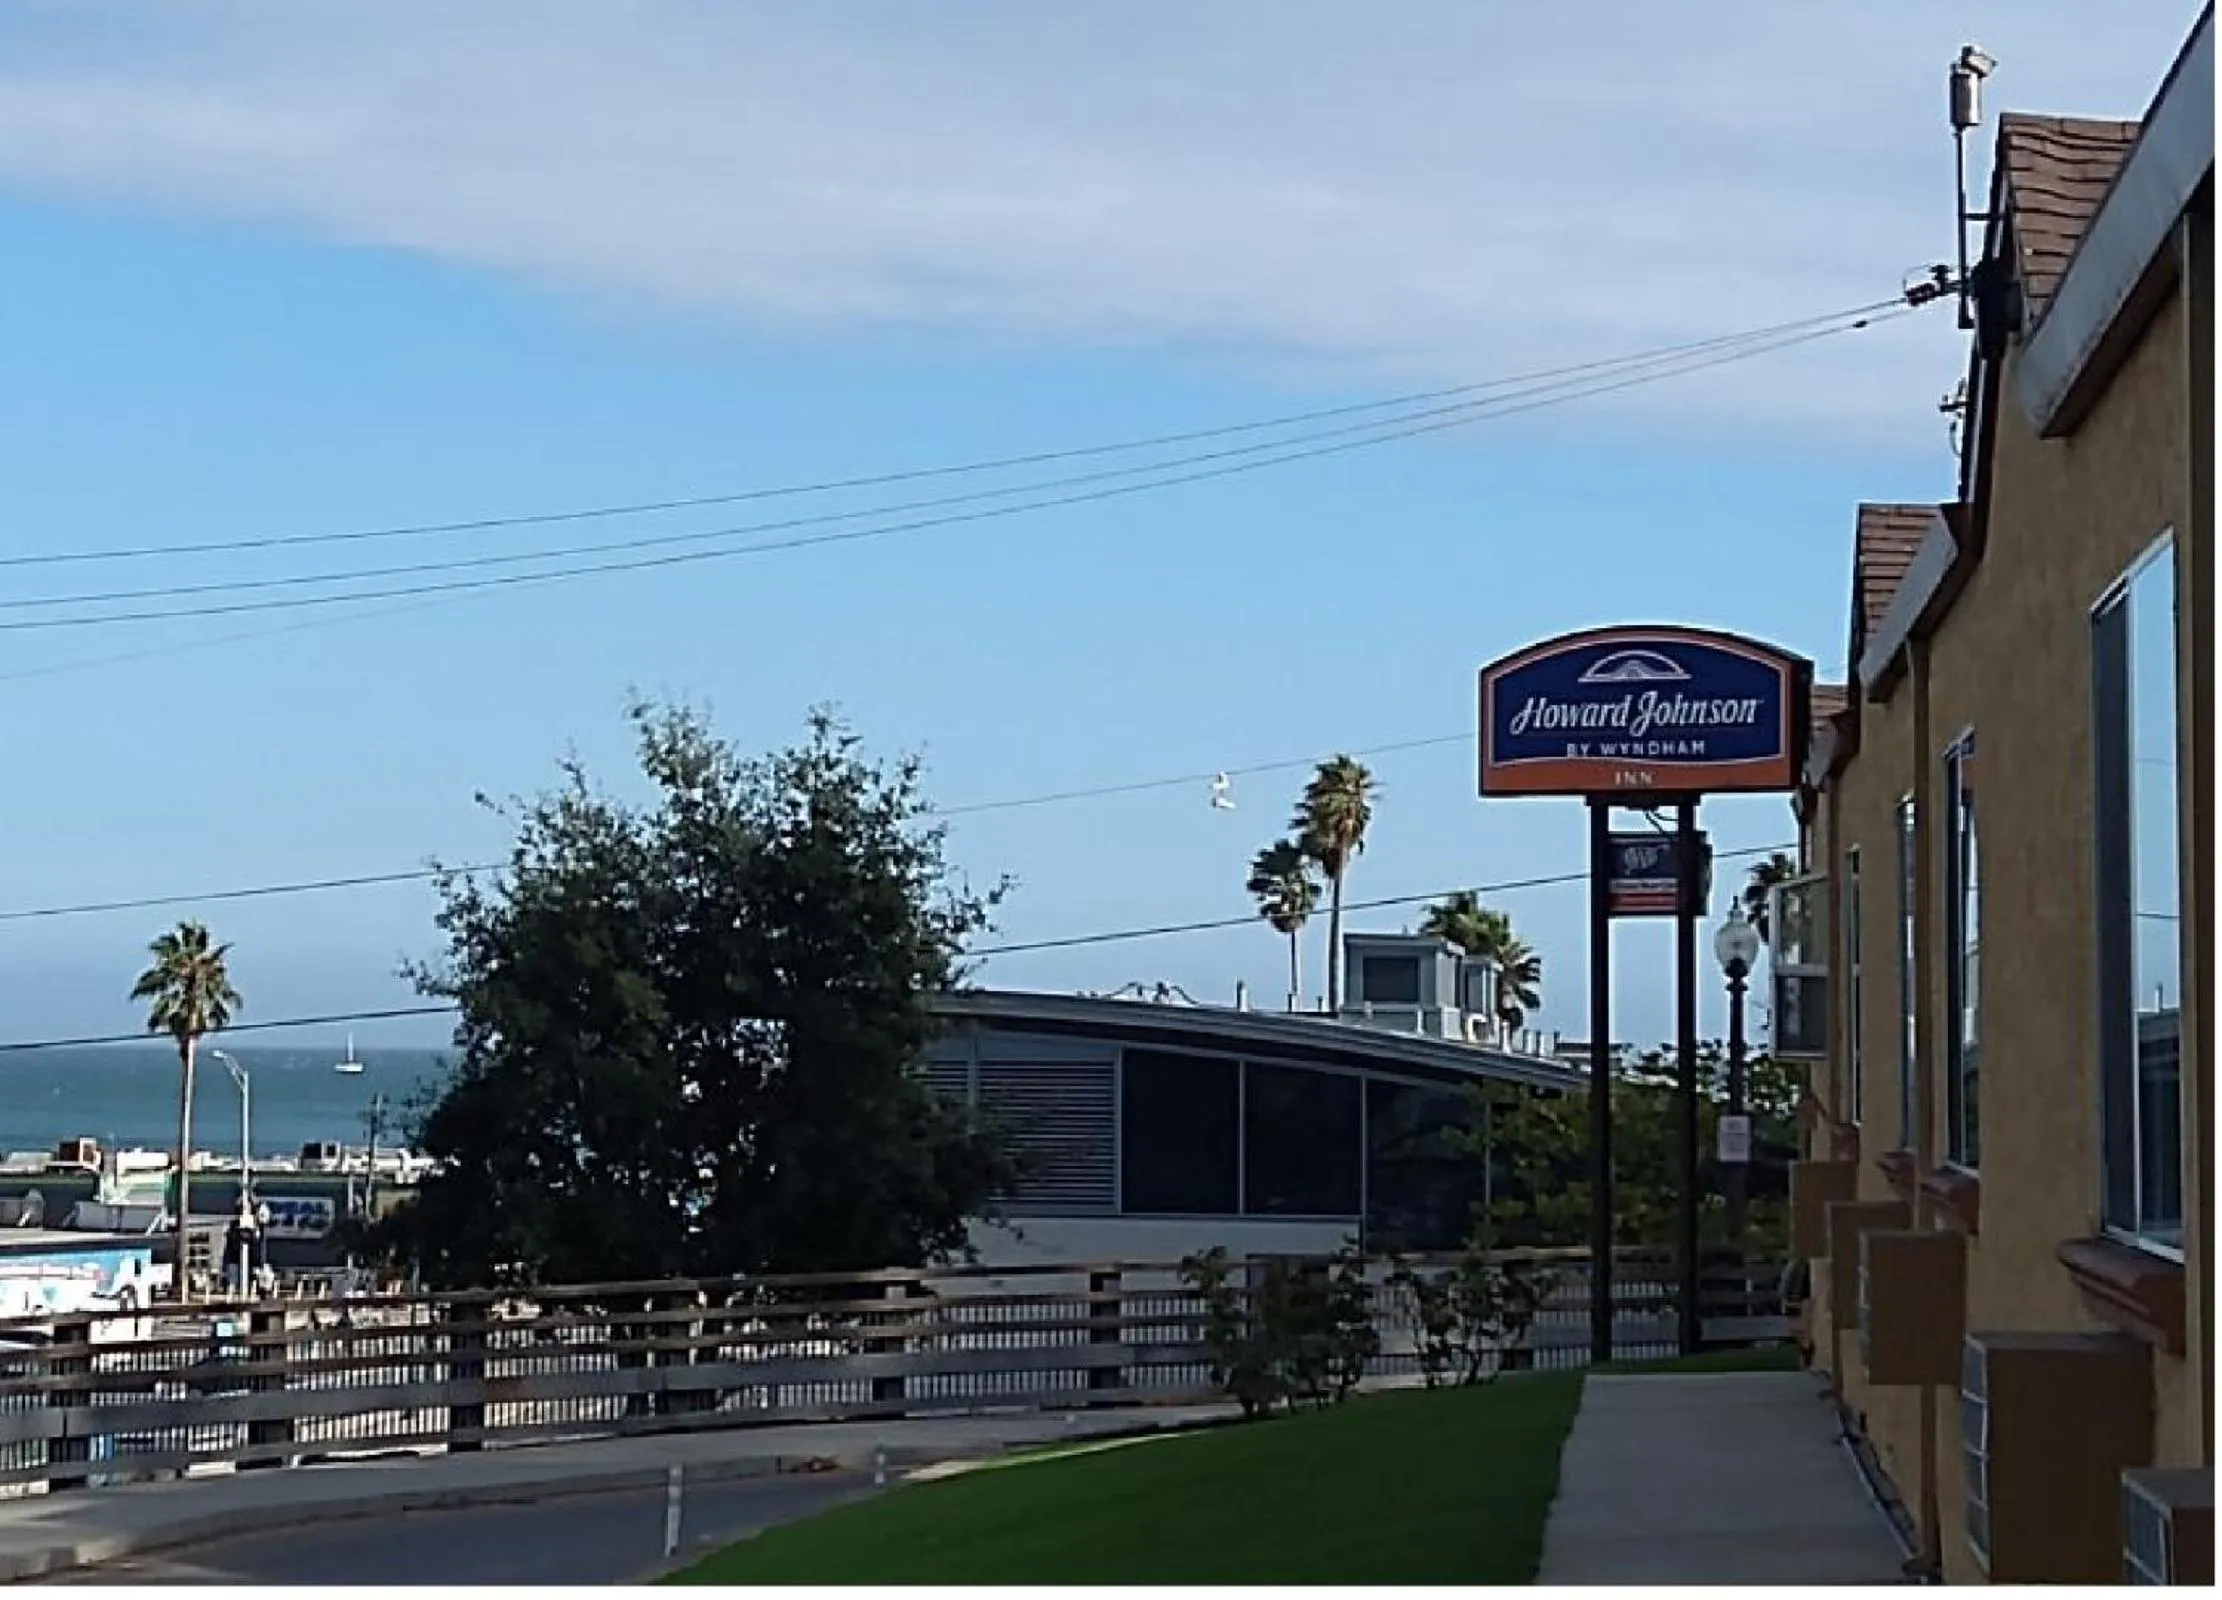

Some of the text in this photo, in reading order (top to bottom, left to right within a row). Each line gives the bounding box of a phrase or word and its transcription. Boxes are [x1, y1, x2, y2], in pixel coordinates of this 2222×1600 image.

[1510, 691, 1758, 736] Howard Johnson
[1567, 740, 1705, 756] BY WYNDHAM
[1614, 771, 1653, 785] INN
